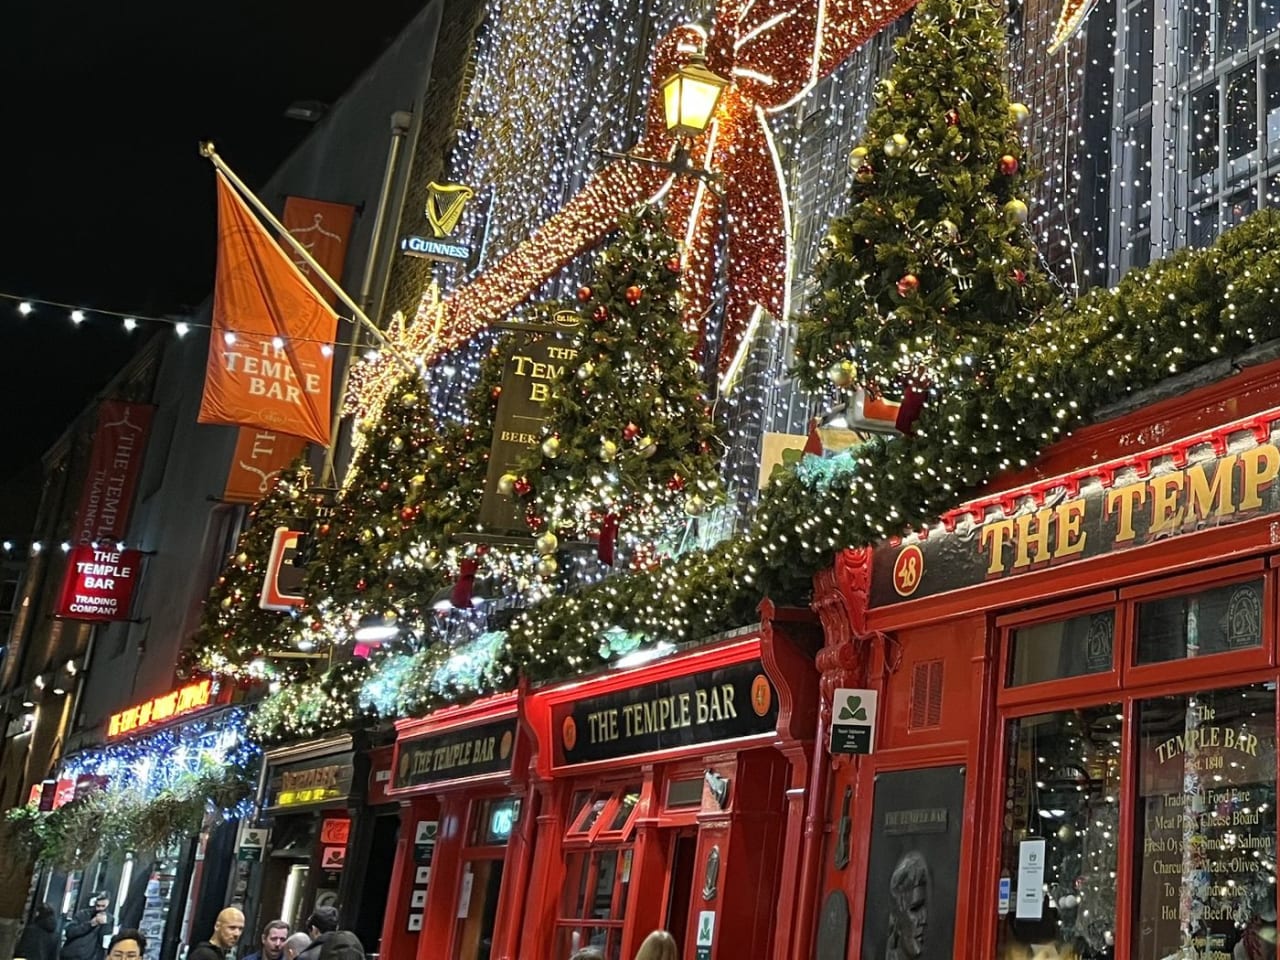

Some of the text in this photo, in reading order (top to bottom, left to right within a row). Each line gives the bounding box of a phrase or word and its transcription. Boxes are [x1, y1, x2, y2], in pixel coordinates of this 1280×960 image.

[409, 238, 470, 259] GUINNESS
[221, 351, 321, 393] TEMPE
[248, 377, 301, 406] BAR
[114, 433, 135, 470] THE
[84, 469, 106, 527] TRADING
[96, 473, 126, 543] TEMPL
[980, 498, 1088, 575] THE
[94, 550, 120, 563] THE
[76, 562, 131, 578] TEMPLE
[898, 556, 917, 588] 48
[84, 577, 115, 590] BAR
[69, 604, 118, 615] COMPANY
[75, 595, 117, 607] TRADING
[588, 683, 738, 744] THE TEMPLE BAR
[1195, 705, 1216, 721] The
[411, 736, 496, 776] THE TEMPLE BAR
[1155, 726, 1258, 765] TEMPLE BAR
[1233, 808, 1259, 826] Board
[1238, 834, 1271, 849] Salmon
[1163, 882, 1175, 897] To
[1161, 906, 1177, 920] Hot
